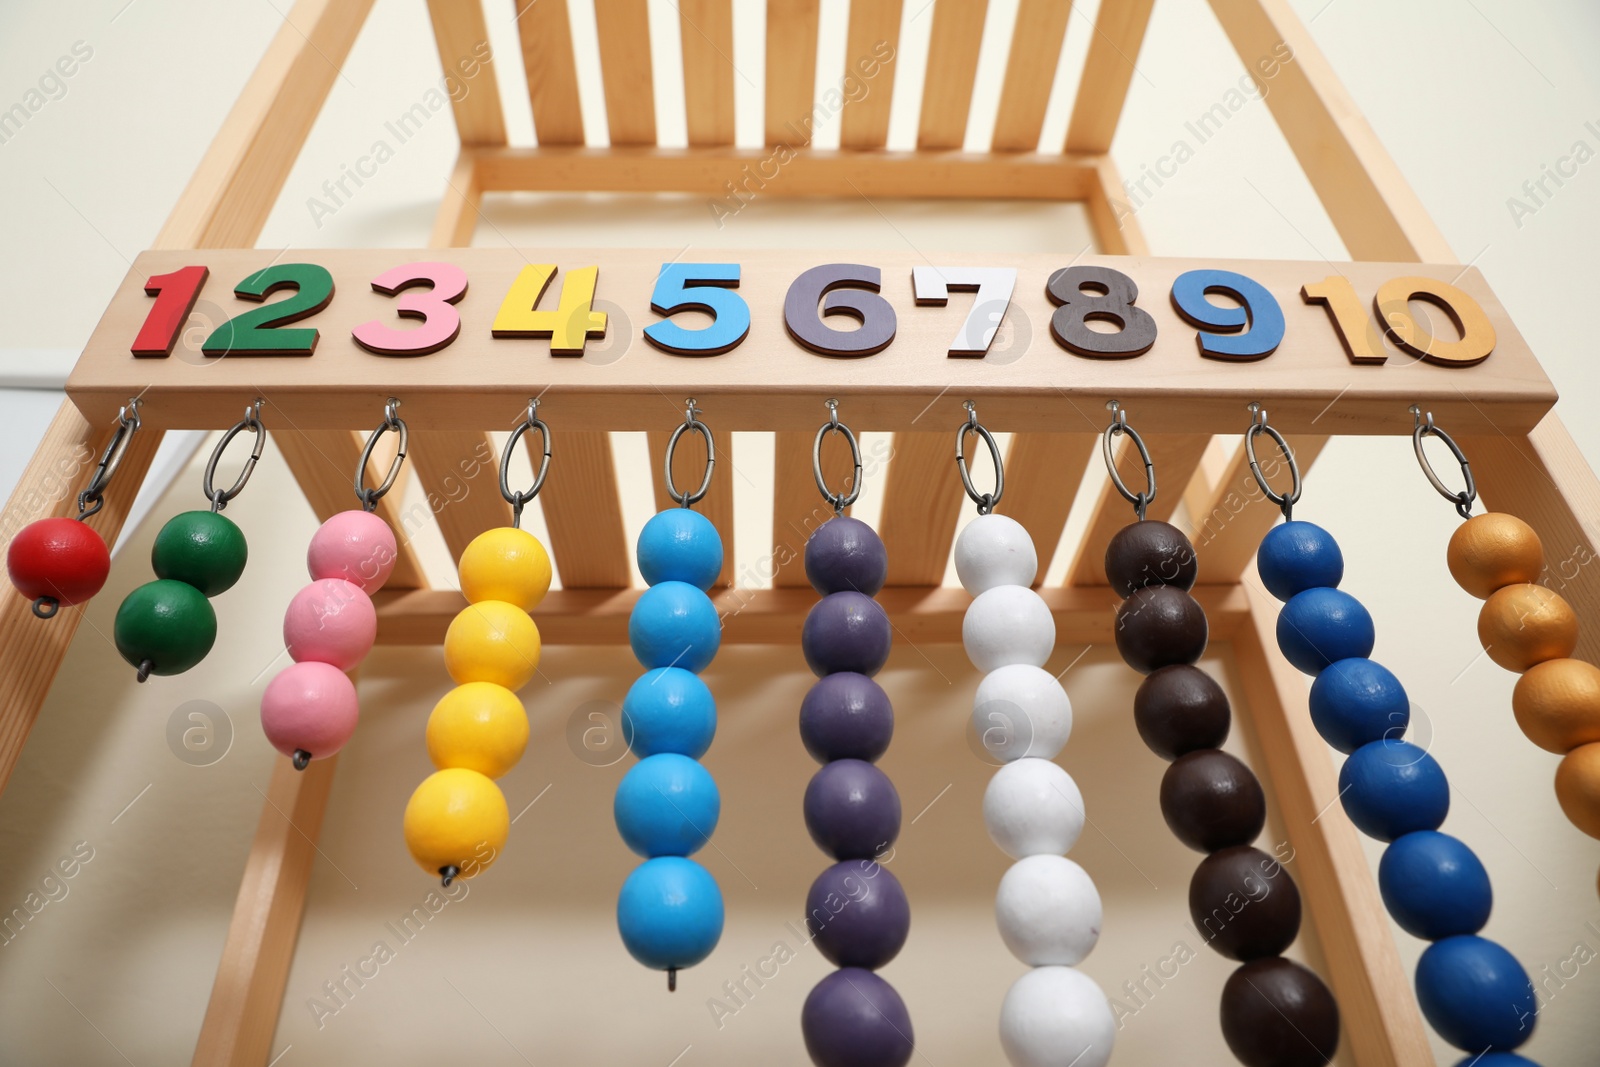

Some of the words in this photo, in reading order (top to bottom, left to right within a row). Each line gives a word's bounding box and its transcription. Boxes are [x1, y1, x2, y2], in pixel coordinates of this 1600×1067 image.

[130, 266, 210, 358] 1
[201, 263, 335, 357] 2
[351, 262, 468, 357] 3
[491, 264, 608, 357] 4
[643, 263, 750, 357] 5
[784, 263, 897, 359] 6
[912, 267, 1017, 358] 7
[1045, 266, 1157, 360] 8
[1170, 269, 1285, 362] 9
[1300, 276, 1496, 368] 10
